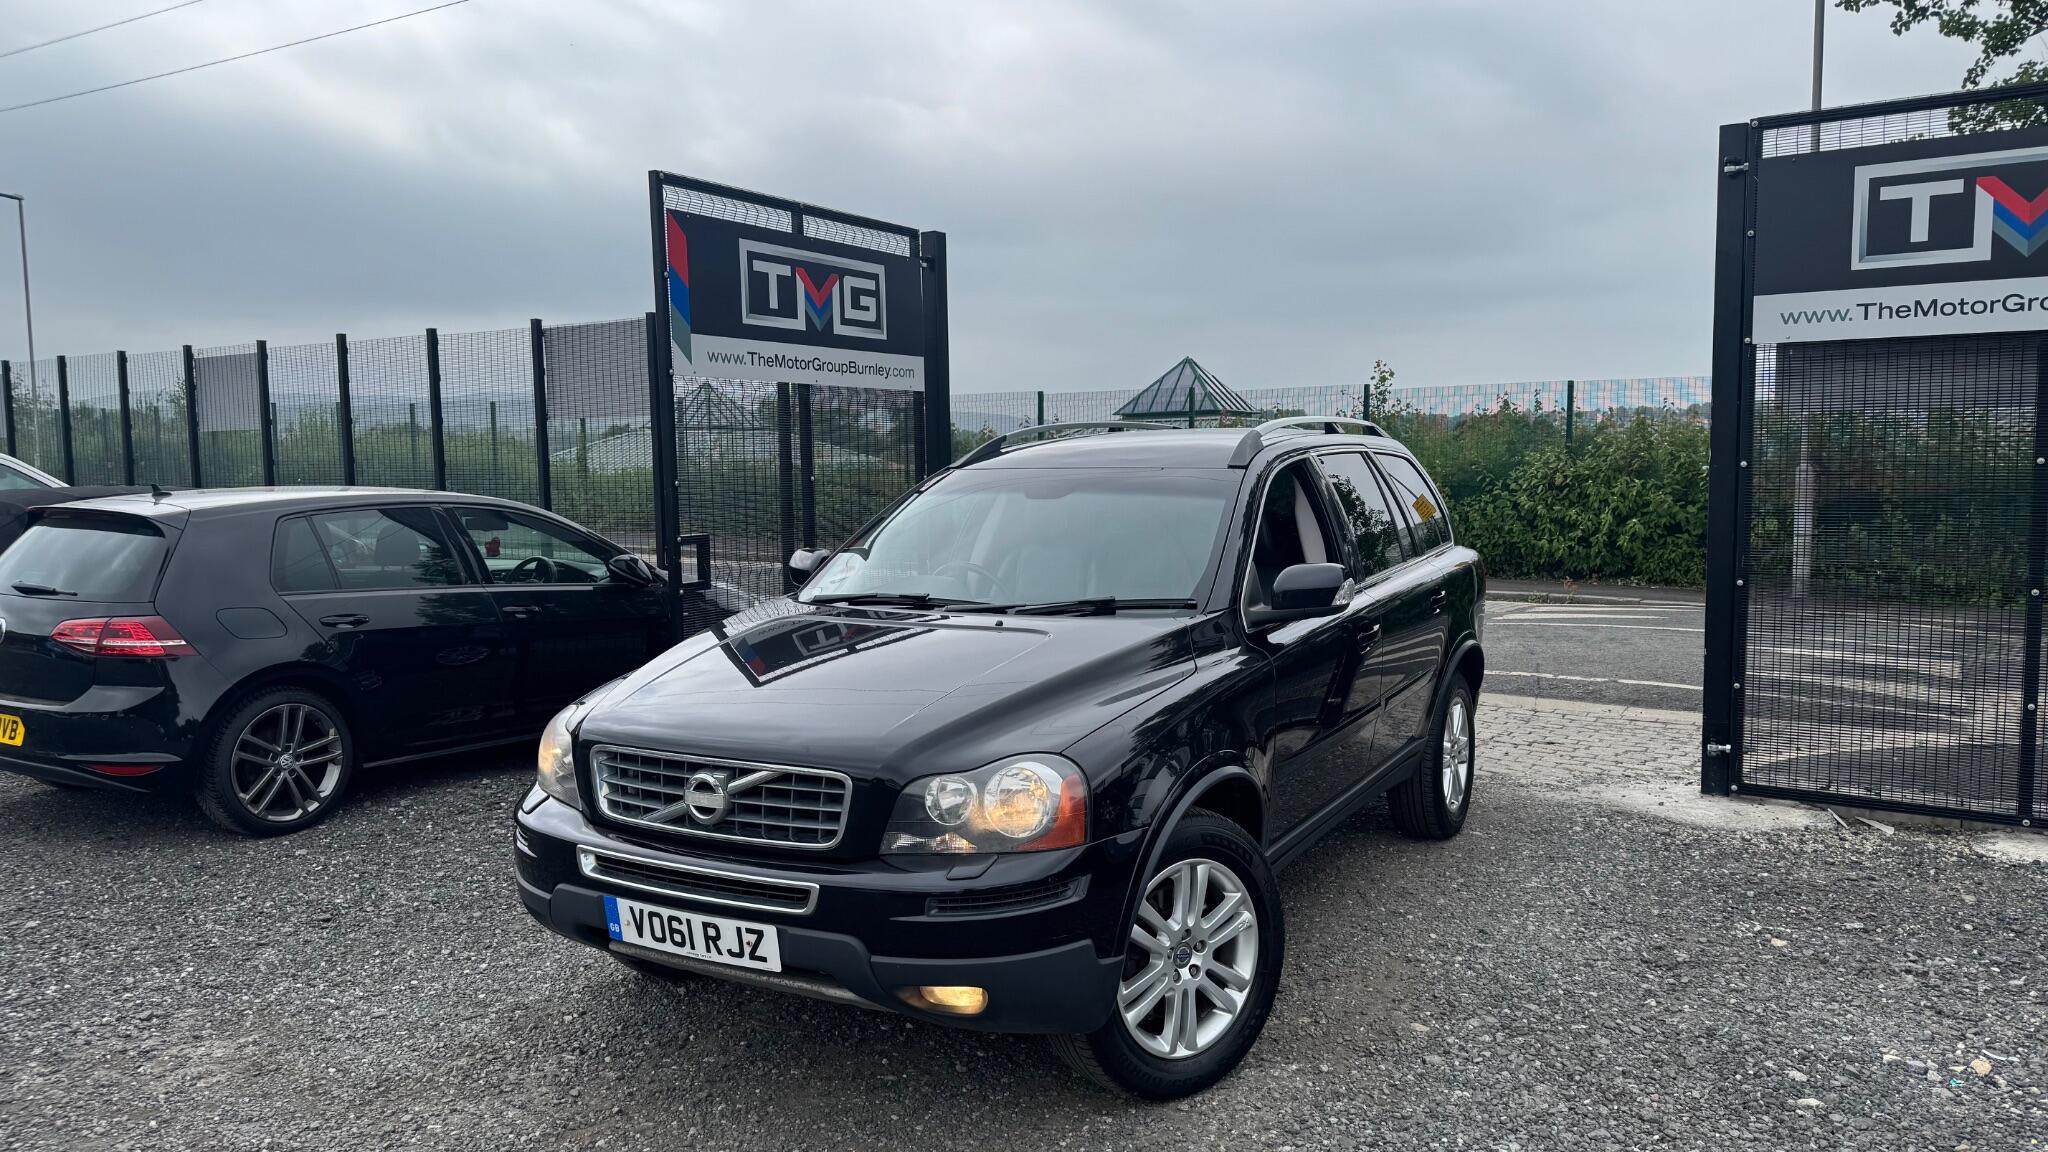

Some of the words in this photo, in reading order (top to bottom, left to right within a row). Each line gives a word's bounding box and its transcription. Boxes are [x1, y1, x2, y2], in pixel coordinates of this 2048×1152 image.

[1880, 175, 2048, 261] TM
[752, 259, 877, 334] TMG
[706, 351, 915, 379] www.TheMotorGroupBurnley.com
[0, 717, 18, 740] VB
[609, 923, 620, 933] GB
[629, 905, 695, 950] VO61
[701, 921, 768, 963] RJZ
